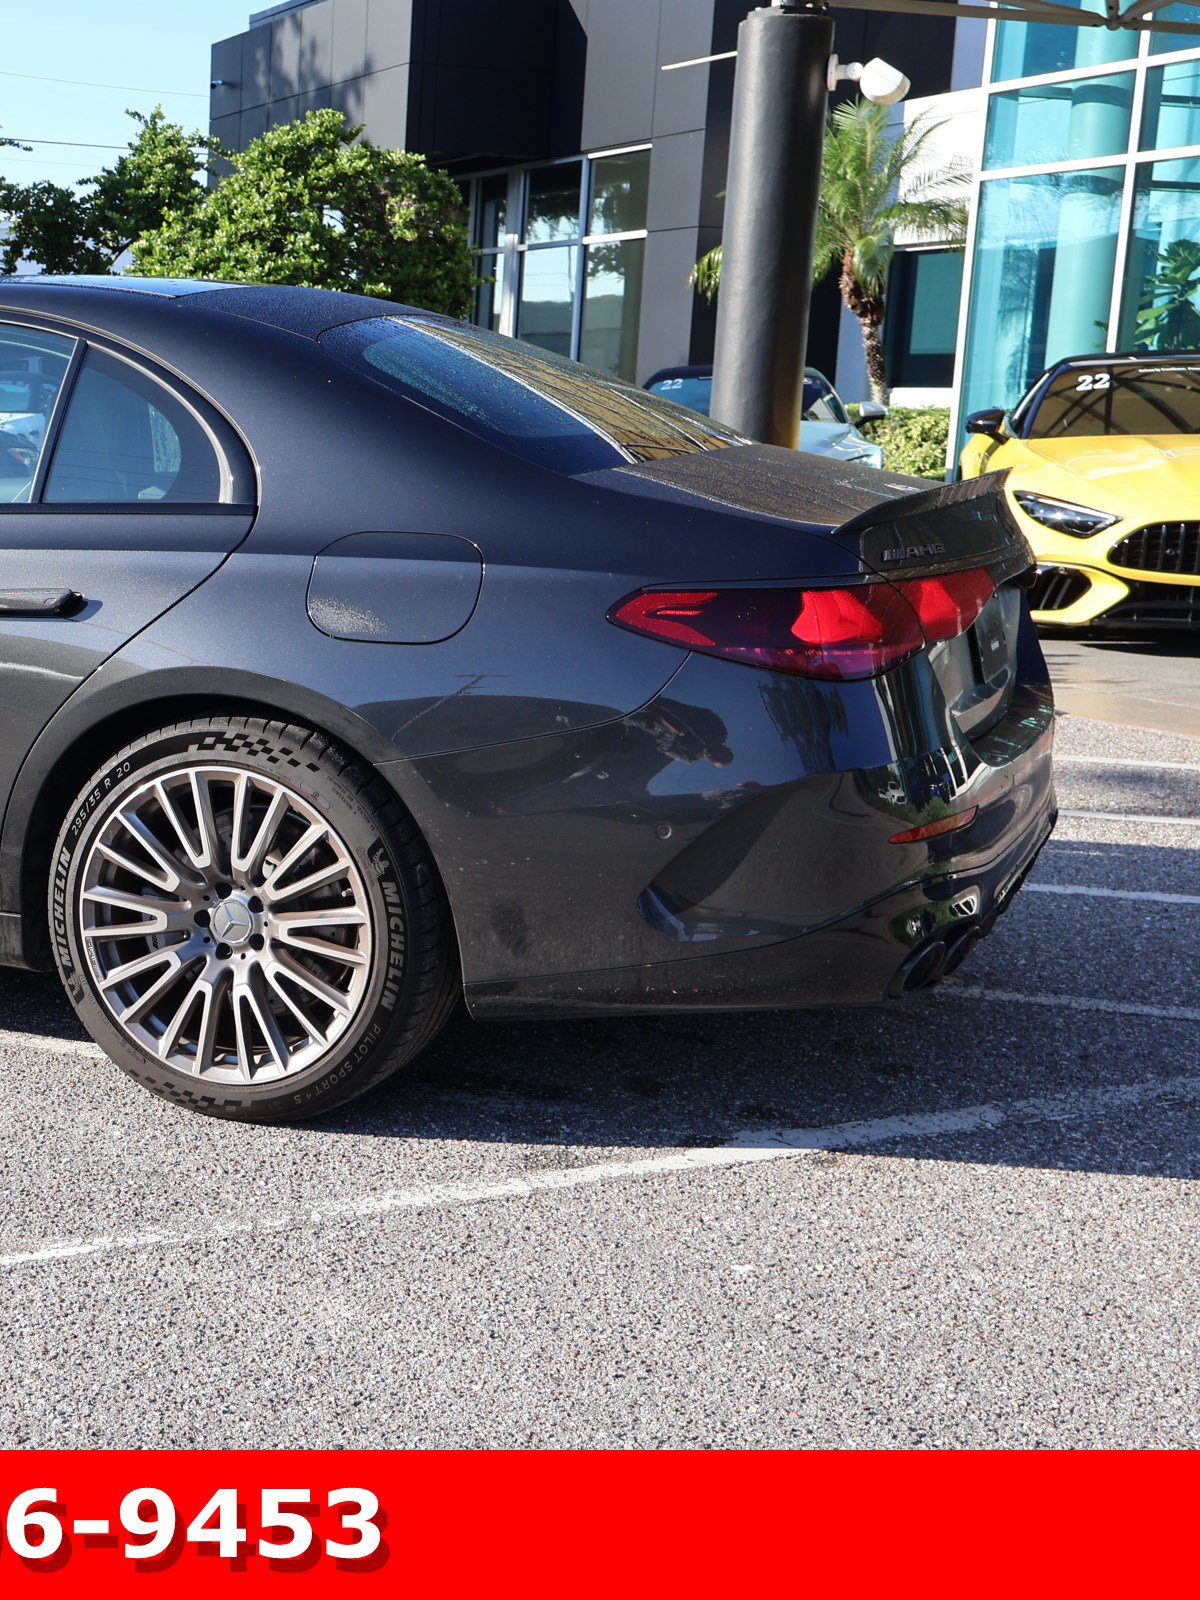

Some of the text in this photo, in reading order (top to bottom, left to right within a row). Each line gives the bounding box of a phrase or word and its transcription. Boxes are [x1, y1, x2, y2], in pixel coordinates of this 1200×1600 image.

[661, 379, 683, 390] 22
[1076, 373, 1110, 391] 22
[72, 762, 131, 836] 295/35 R 20
[54, 846, 73, 967] MICHELIN
[380, 881, 405, 1012] MICHELIN
[354, 1023, 381, 1063] PILOT
[315, 1061, 354, 1096] SPORT
[293, 1094, 302, 1104] S
